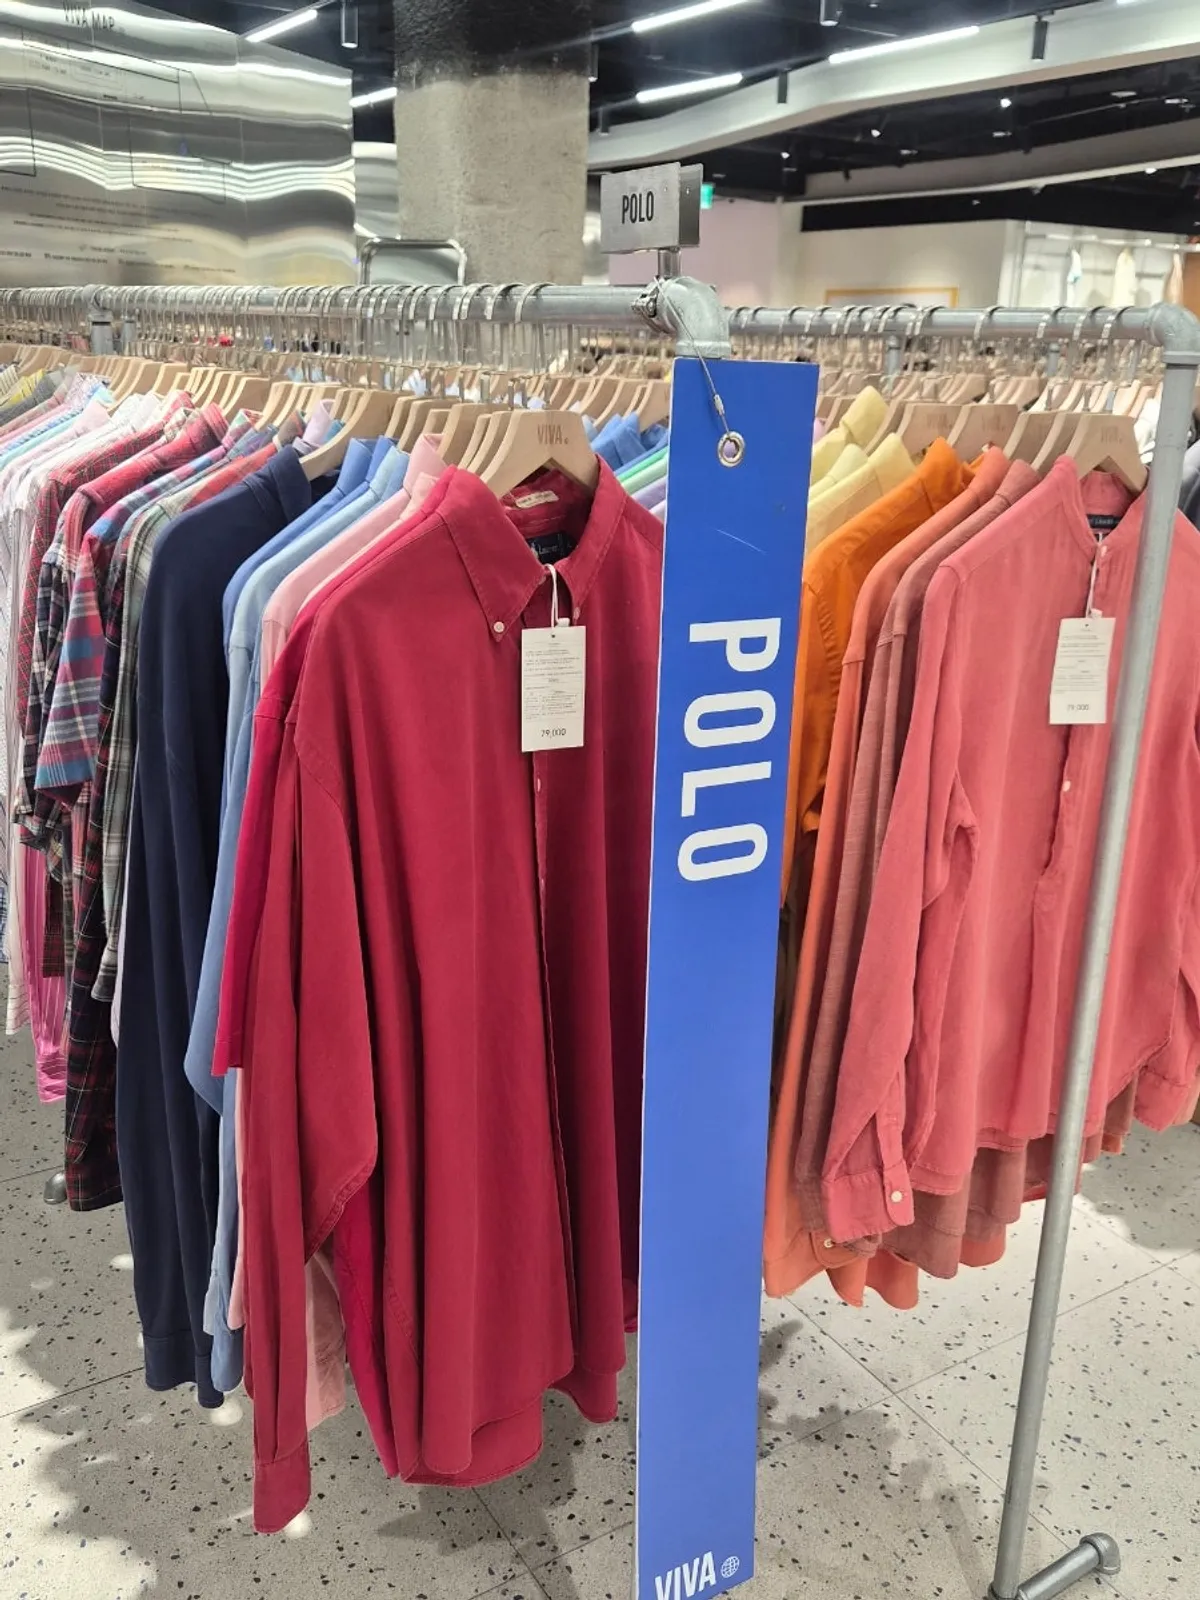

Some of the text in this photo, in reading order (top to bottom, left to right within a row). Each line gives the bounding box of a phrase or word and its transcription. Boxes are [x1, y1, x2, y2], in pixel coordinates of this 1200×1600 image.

[91, 11, 115, 32] MAP
[622, 191, 654, 224] POLO
[677, 617, 782, 882] POLO
[654, 1551, 717, 1600] VIVA
